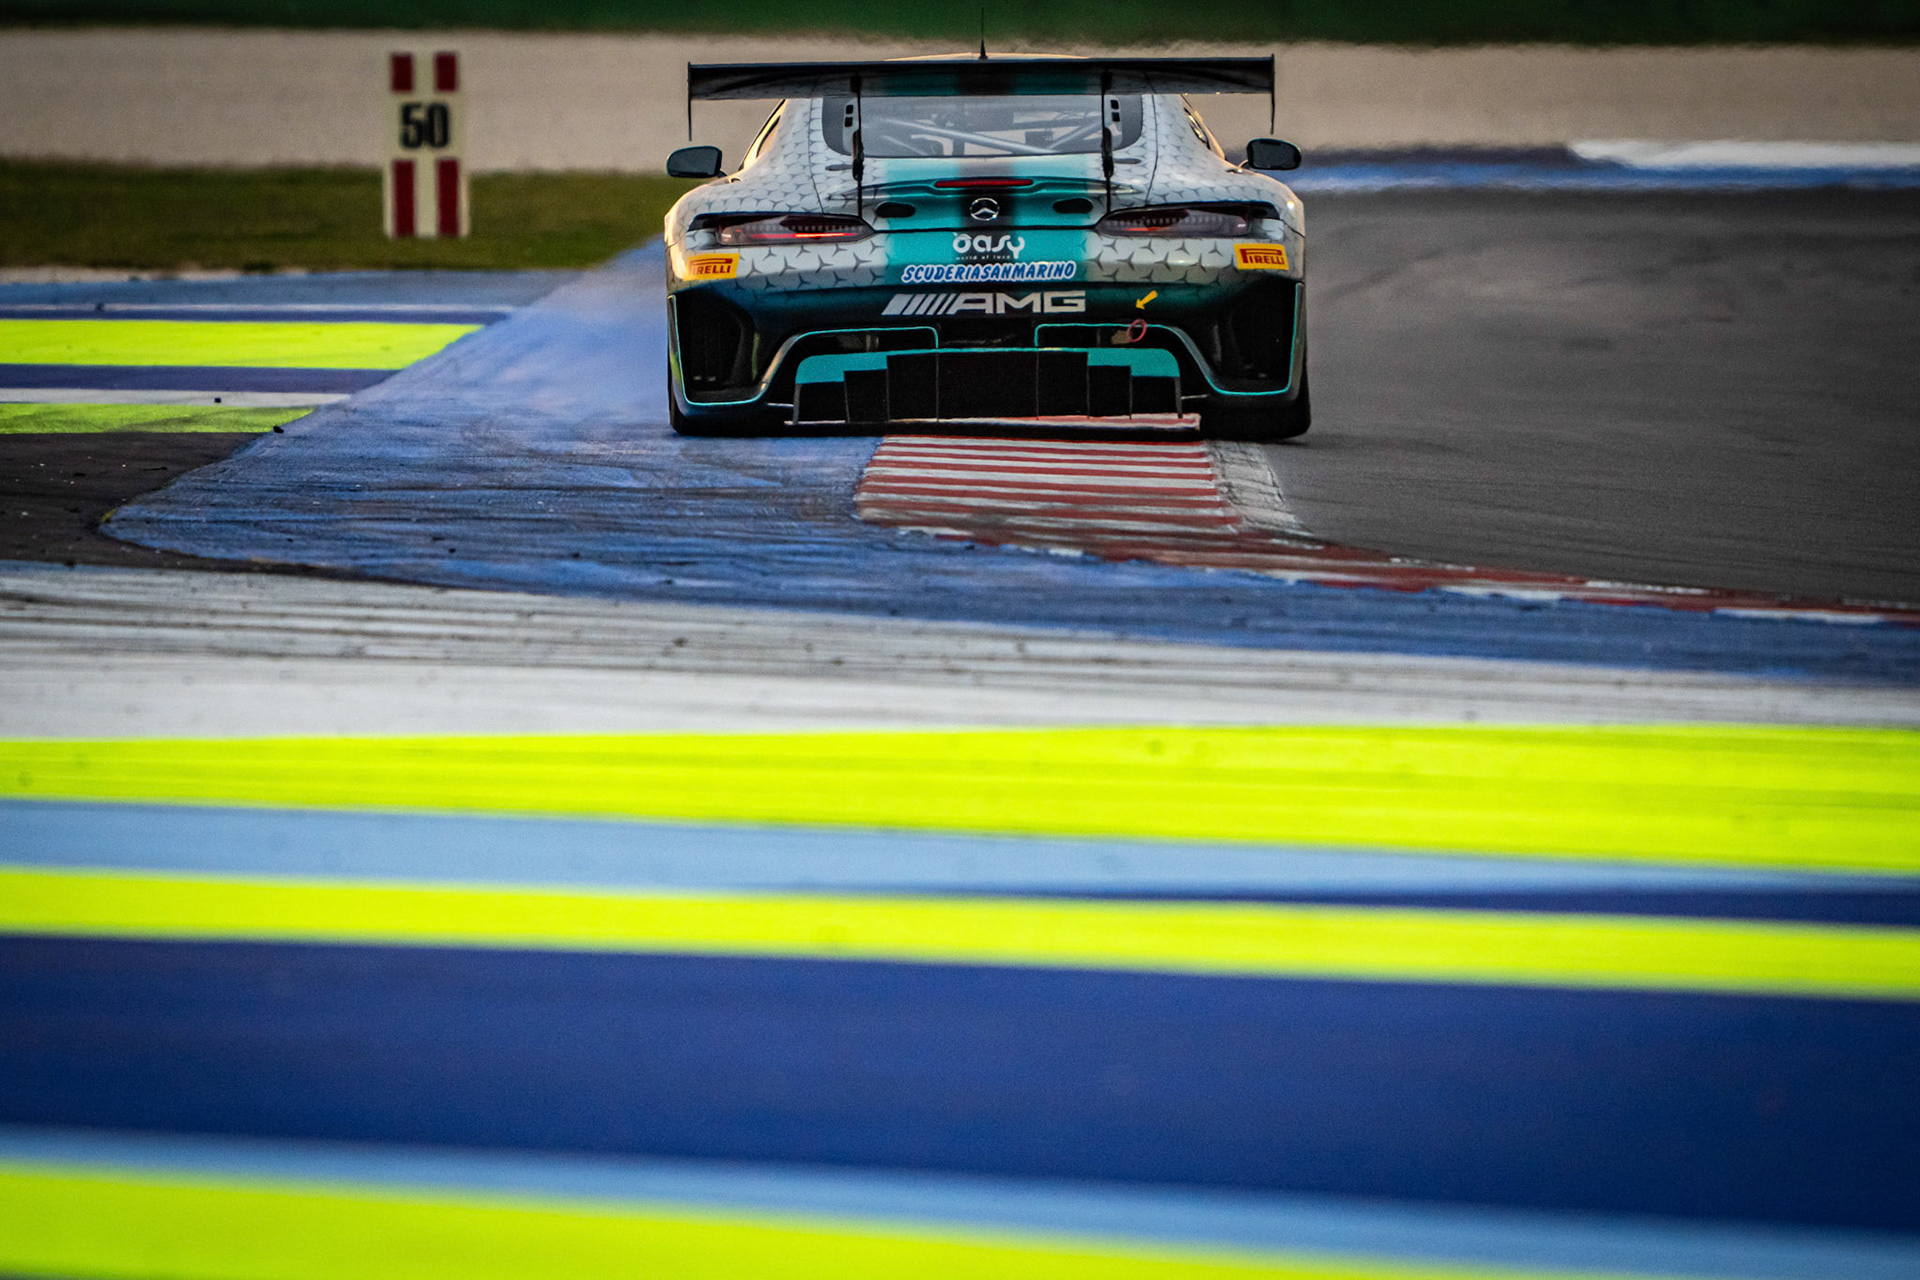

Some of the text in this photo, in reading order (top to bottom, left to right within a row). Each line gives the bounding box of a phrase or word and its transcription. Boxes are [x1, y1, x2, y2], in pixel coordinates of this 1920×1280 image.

[401, 102, 449, 147] 50
[1239, 248, 1285, 265] PIRELLI
[947, 290, 1086, 315] AMG
